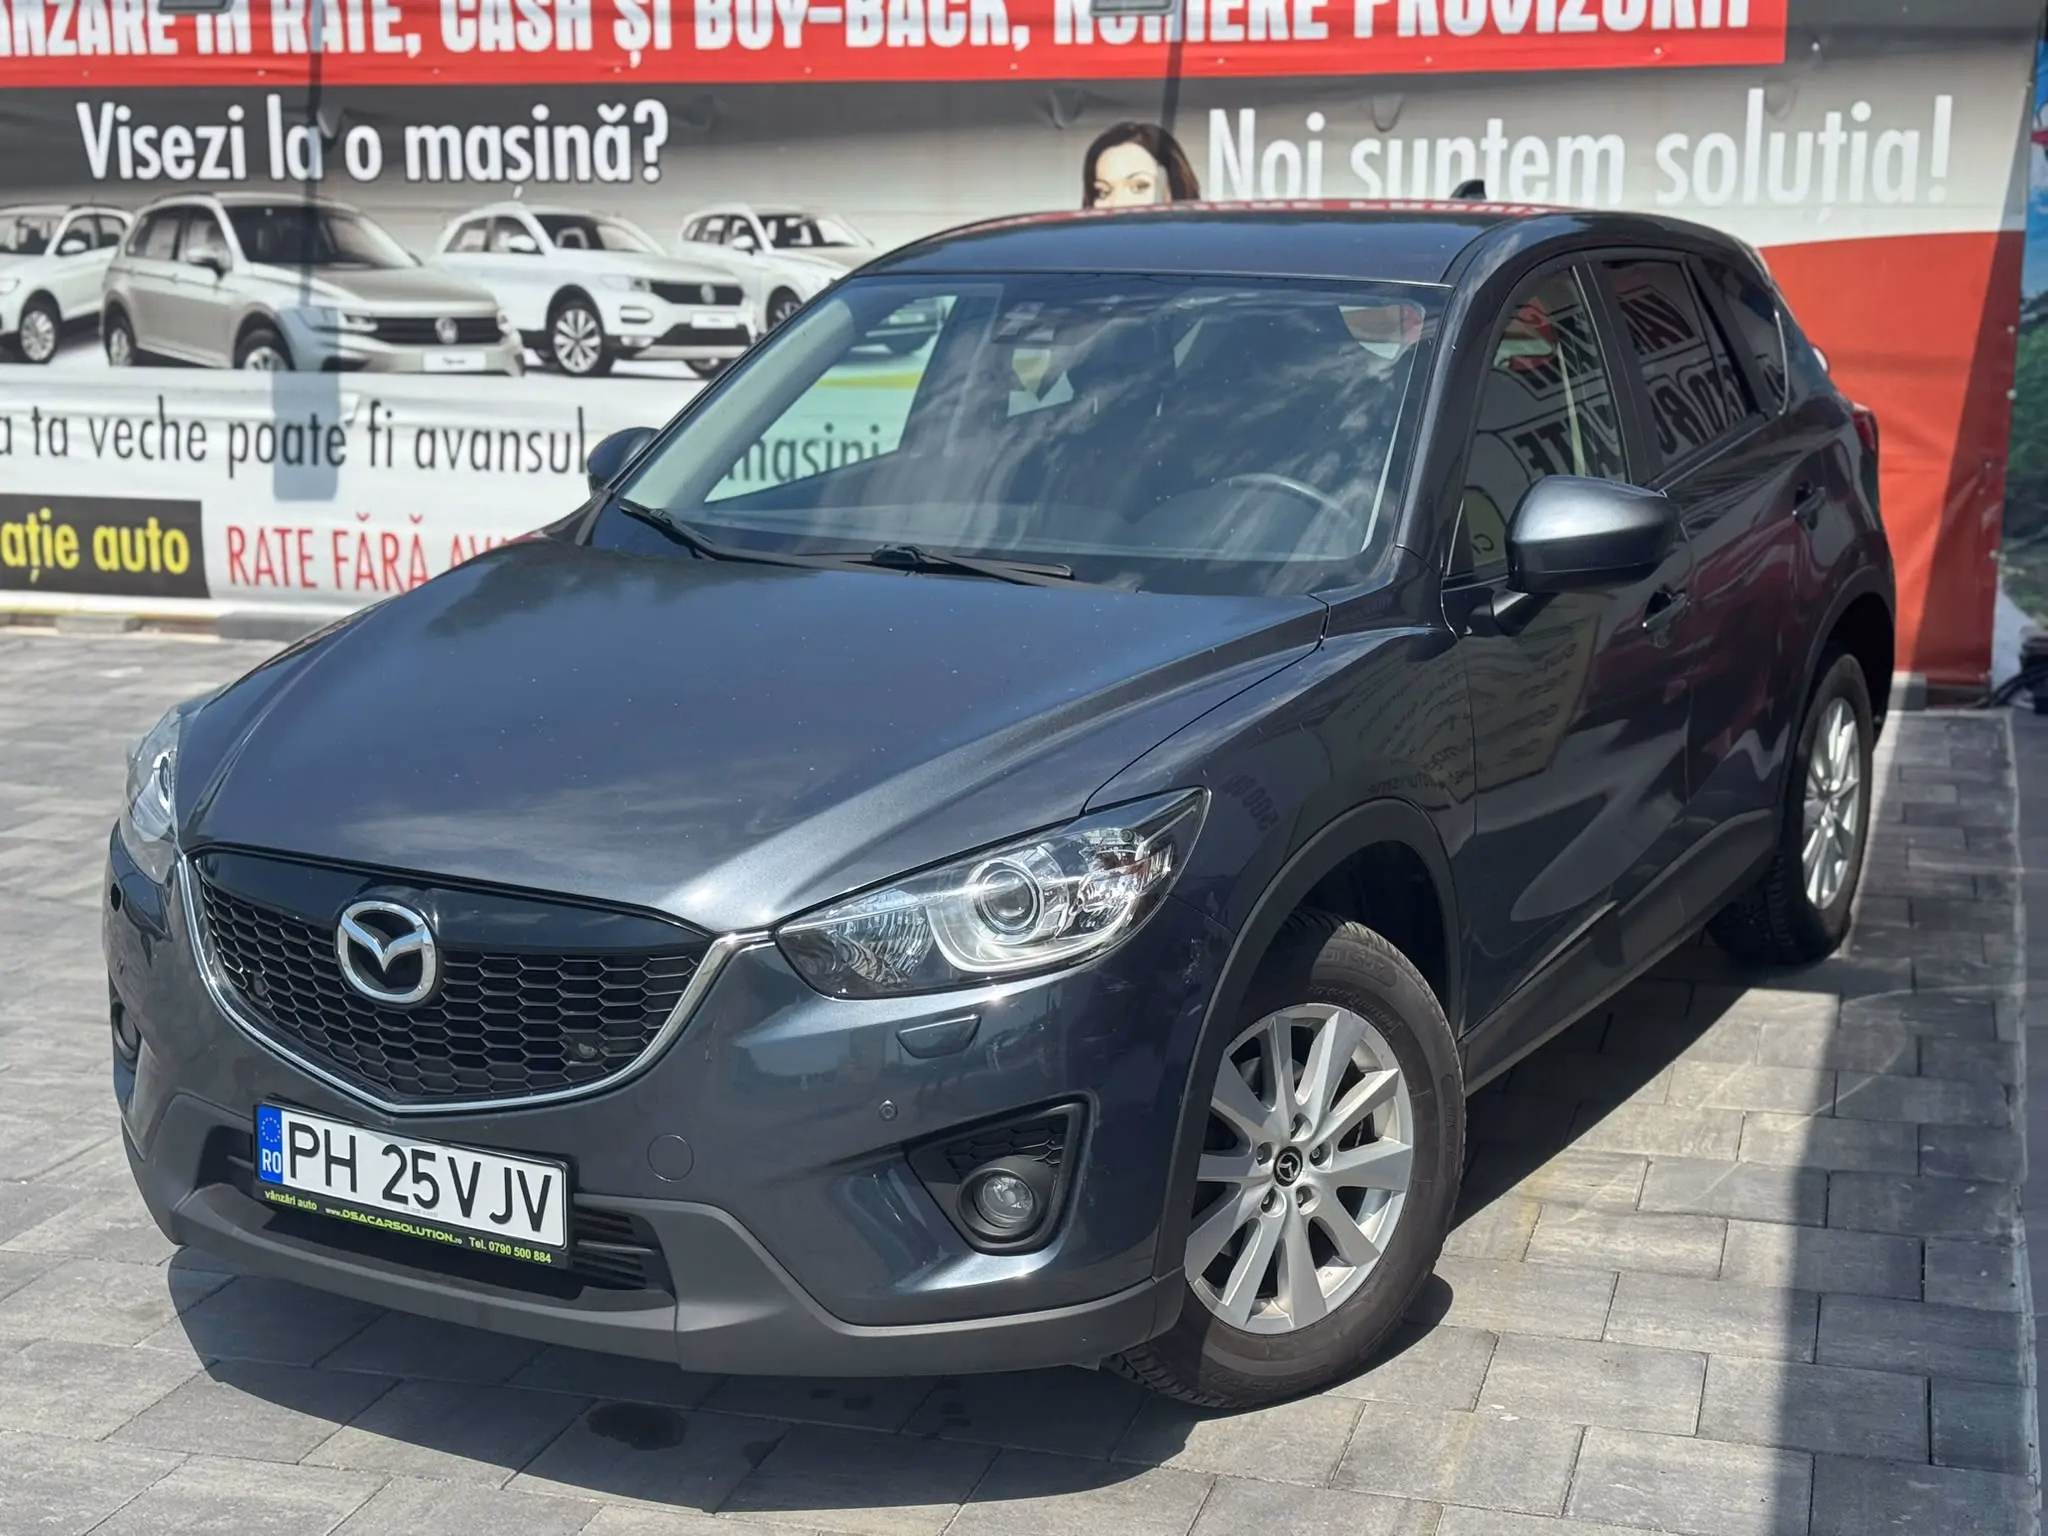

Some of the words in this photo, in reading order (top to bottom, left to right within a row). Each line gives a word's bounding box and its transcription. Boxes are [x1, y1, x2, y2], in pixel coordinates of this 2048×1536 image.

[440, 0, 593, 52] CASH
[76, 101, 246, 181] Visezi
[267, 94, 324, 181] la
[345, 126, 382, 182] o
[405, 99, 669, 199] mașină?
[1207, 108, 1326, 200] Noi
[1350, 118, 1626, 207] suntem
[1655, 88, 1953, 224] soluția!
[31, 406, 69, 457] ta
[88, 394, 208, 461] veche
[227, 413, 348, 479] poate
[366, 400, 394, 468] fi
[414, 406, 587, 474] avansul
[93, 516, 190, 575] auto
[227, 525, 319, 589] RATE
[332, 512, 430, 594] FĂRĂ
[262, 1148, 282, 1174] RO
[288, 1120, 358, 1194] PH
[297, 1199, 318, 1212] auto
[469, 1236, 487, 1251] Tel.
[489, 1241, 512, 1256] 0790
[514, 1246, 532, 1260] 500
[534, 1250, 552, 1264] 884
